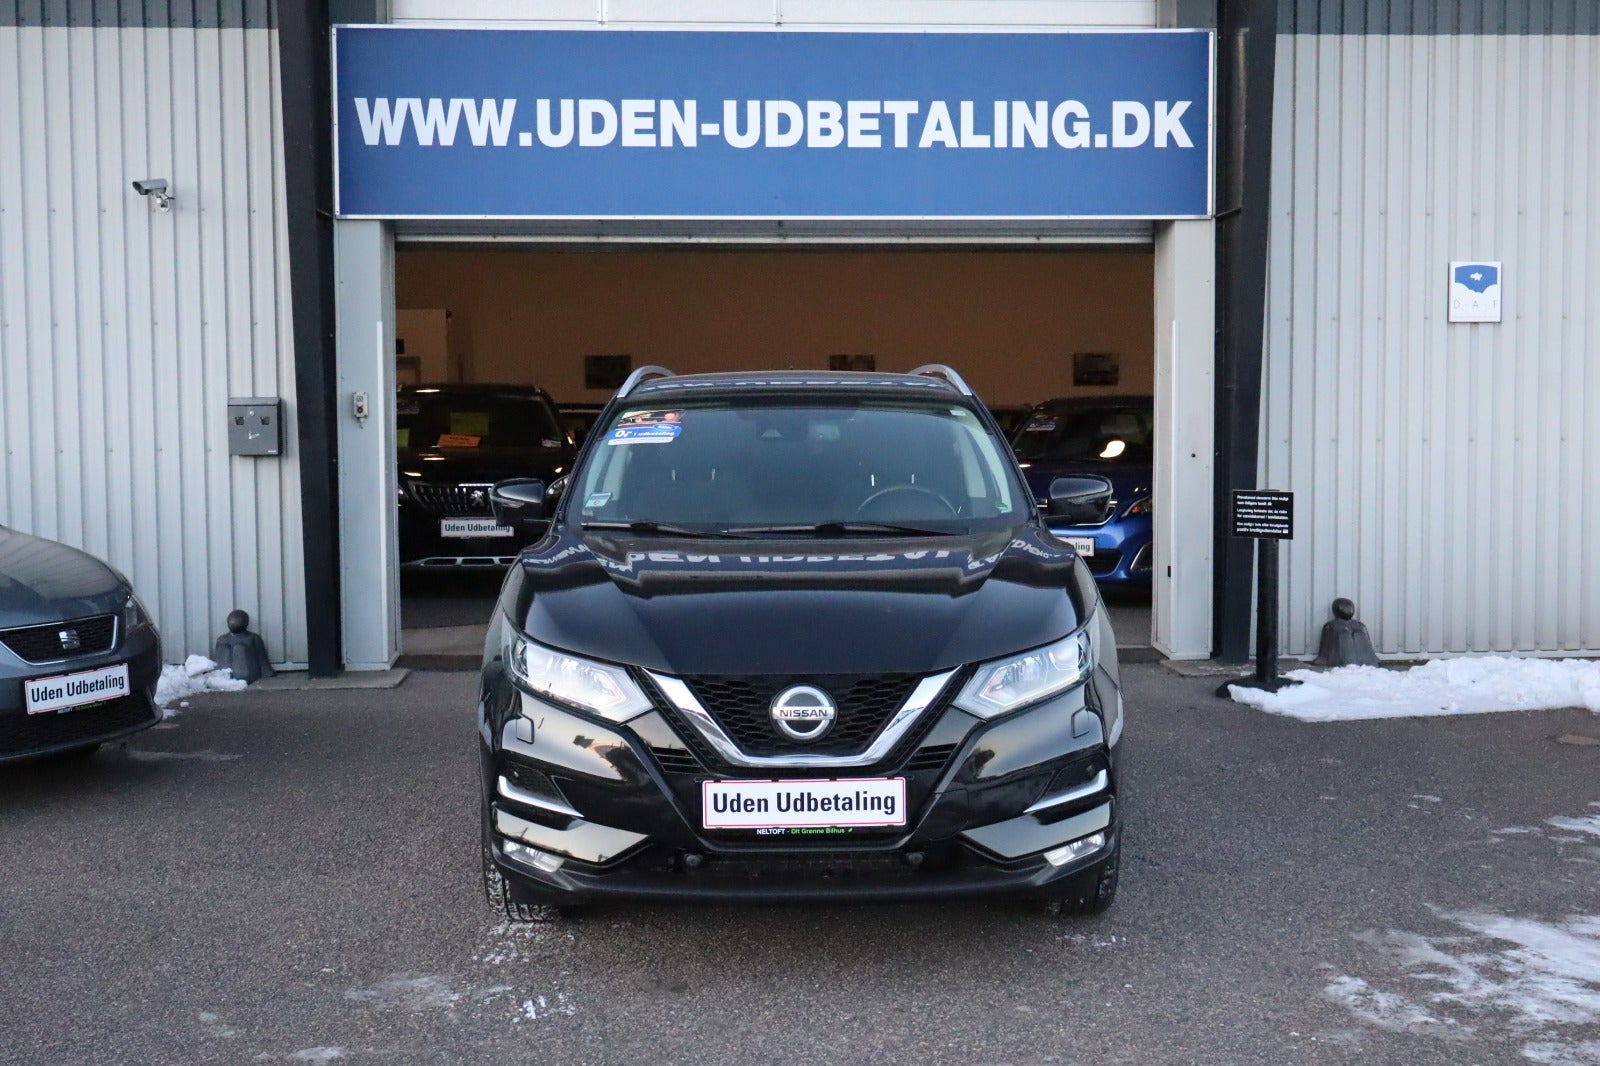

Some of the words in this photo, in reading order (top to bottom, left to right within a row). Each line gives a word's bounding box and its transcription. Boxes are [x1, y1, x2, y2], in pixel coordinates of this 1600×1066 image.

[354, 97, 1195, 149] WWW.UDEN-UDBETALING.DK
[444, 523, 465, 532] Uden
[31, 686, 63, 703] Uden
[66, 675, 125, 696] Udbetaling
[779, 709, 828, 718] NISSAN
[713, 792, 769, 814] Uden
[776, 791, 896, 815] Udbetaling
